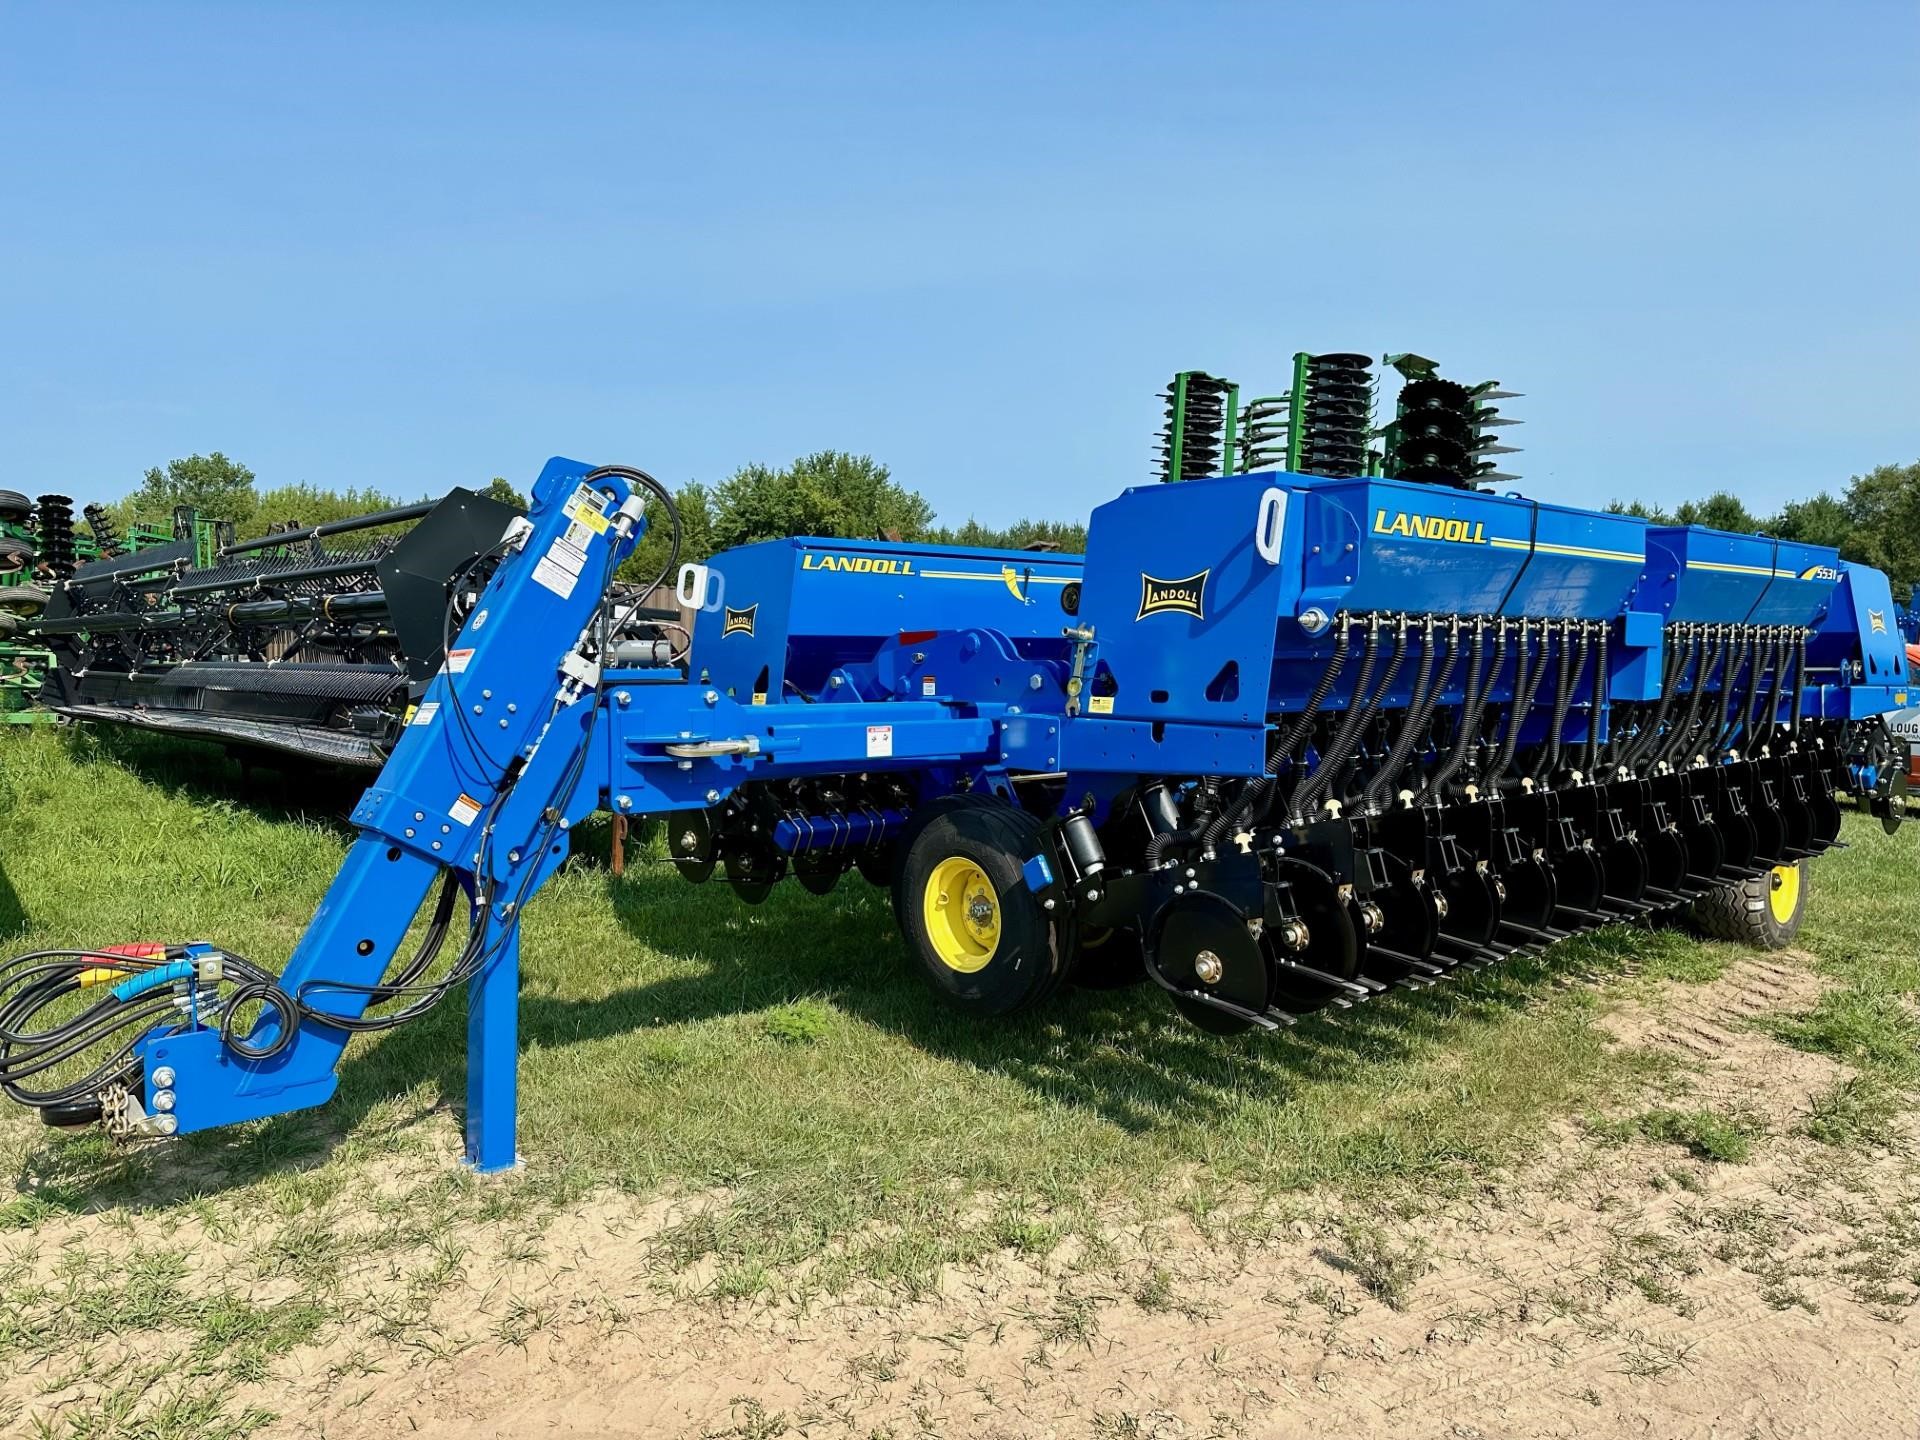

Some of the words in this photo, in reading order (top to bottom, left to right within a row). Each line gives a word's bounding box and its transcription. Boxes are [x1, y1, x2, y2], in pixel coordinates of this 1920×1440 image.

[1373, 509, 1488, 545] LANDOLL
[802, 554, 916, 576] LANDOLL
[1144, 583, 1198, 611] LANDOLL
